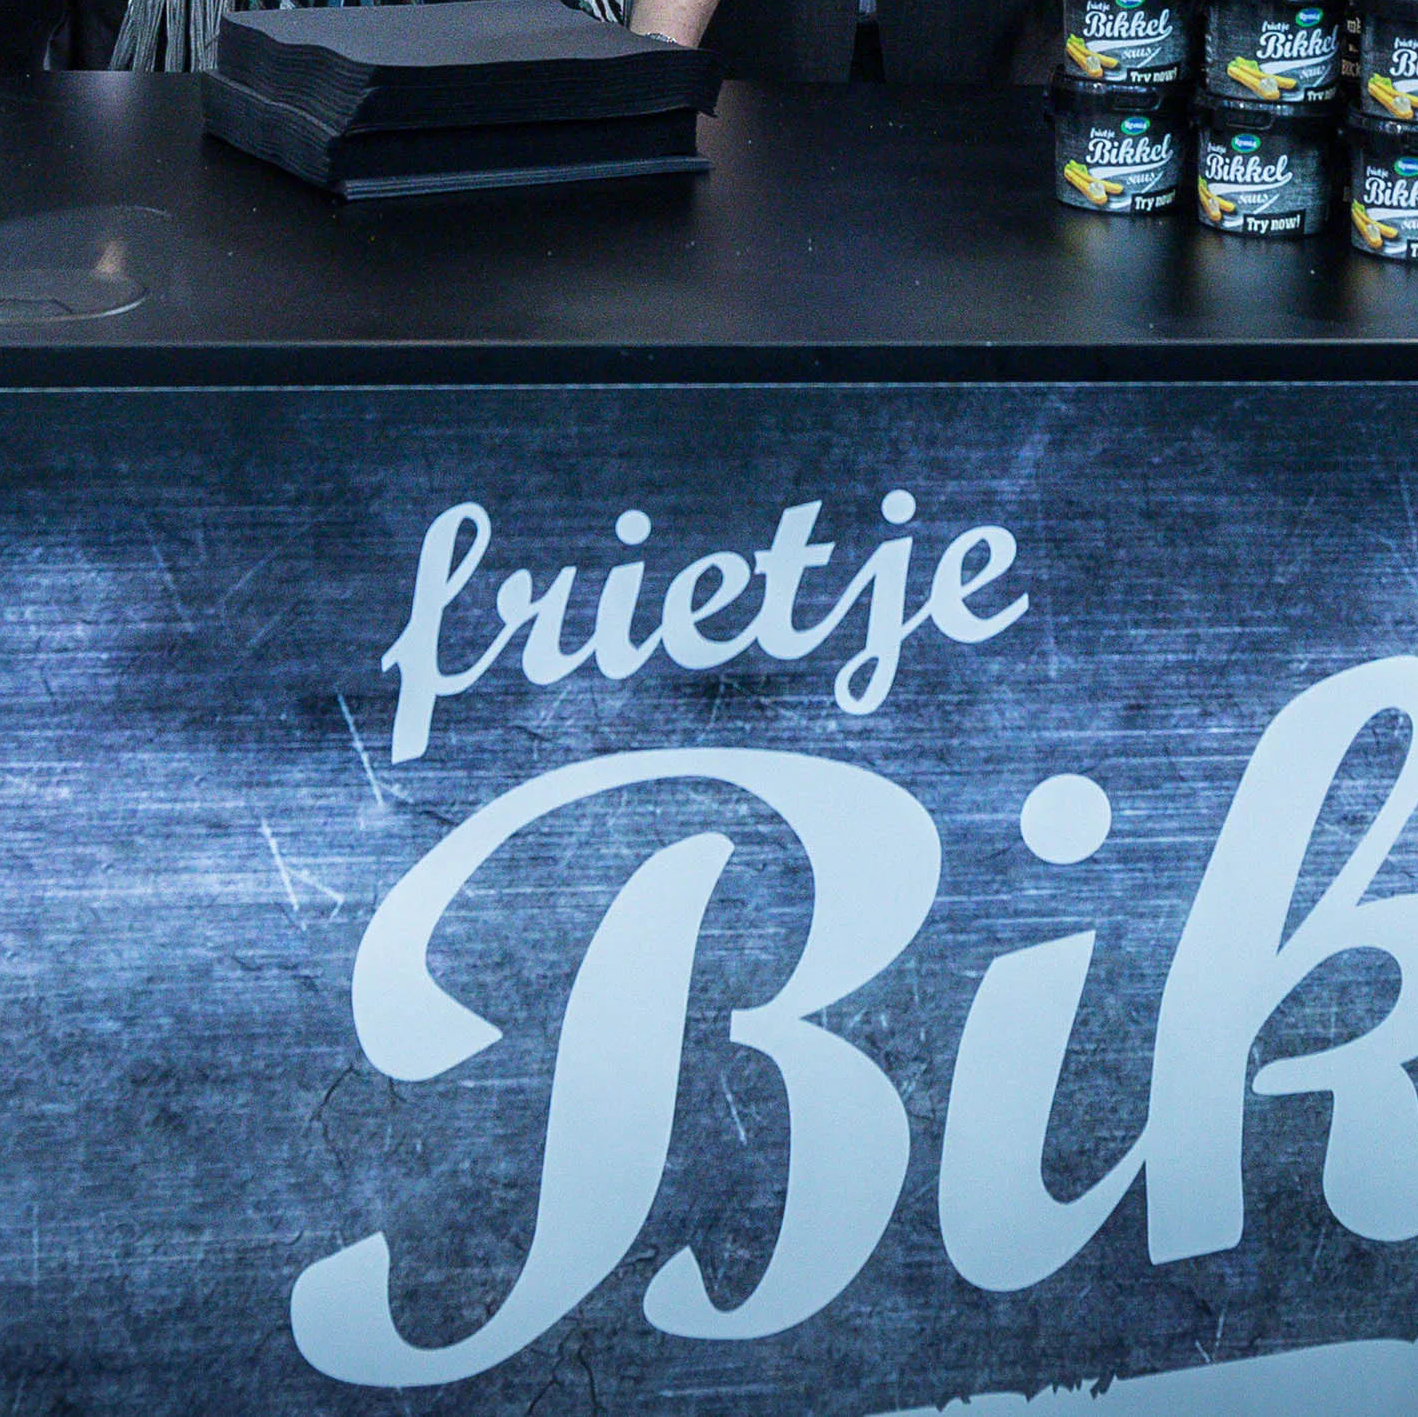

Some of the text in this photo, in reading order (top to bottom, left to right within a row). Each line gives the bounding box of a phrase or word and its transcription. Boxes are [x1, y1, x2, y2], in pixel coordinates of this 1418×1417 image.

[1083, 8, 1173, 38] Bikkel
[1085, 133, 1174, 165] Bikkel
[1205, 154, 1294, 183] Bikkel
[1135, 196, 1155, 211] Try
[1246, 214, 1301, 234] Try now!
[383, 487, 1030, 762] frietje
